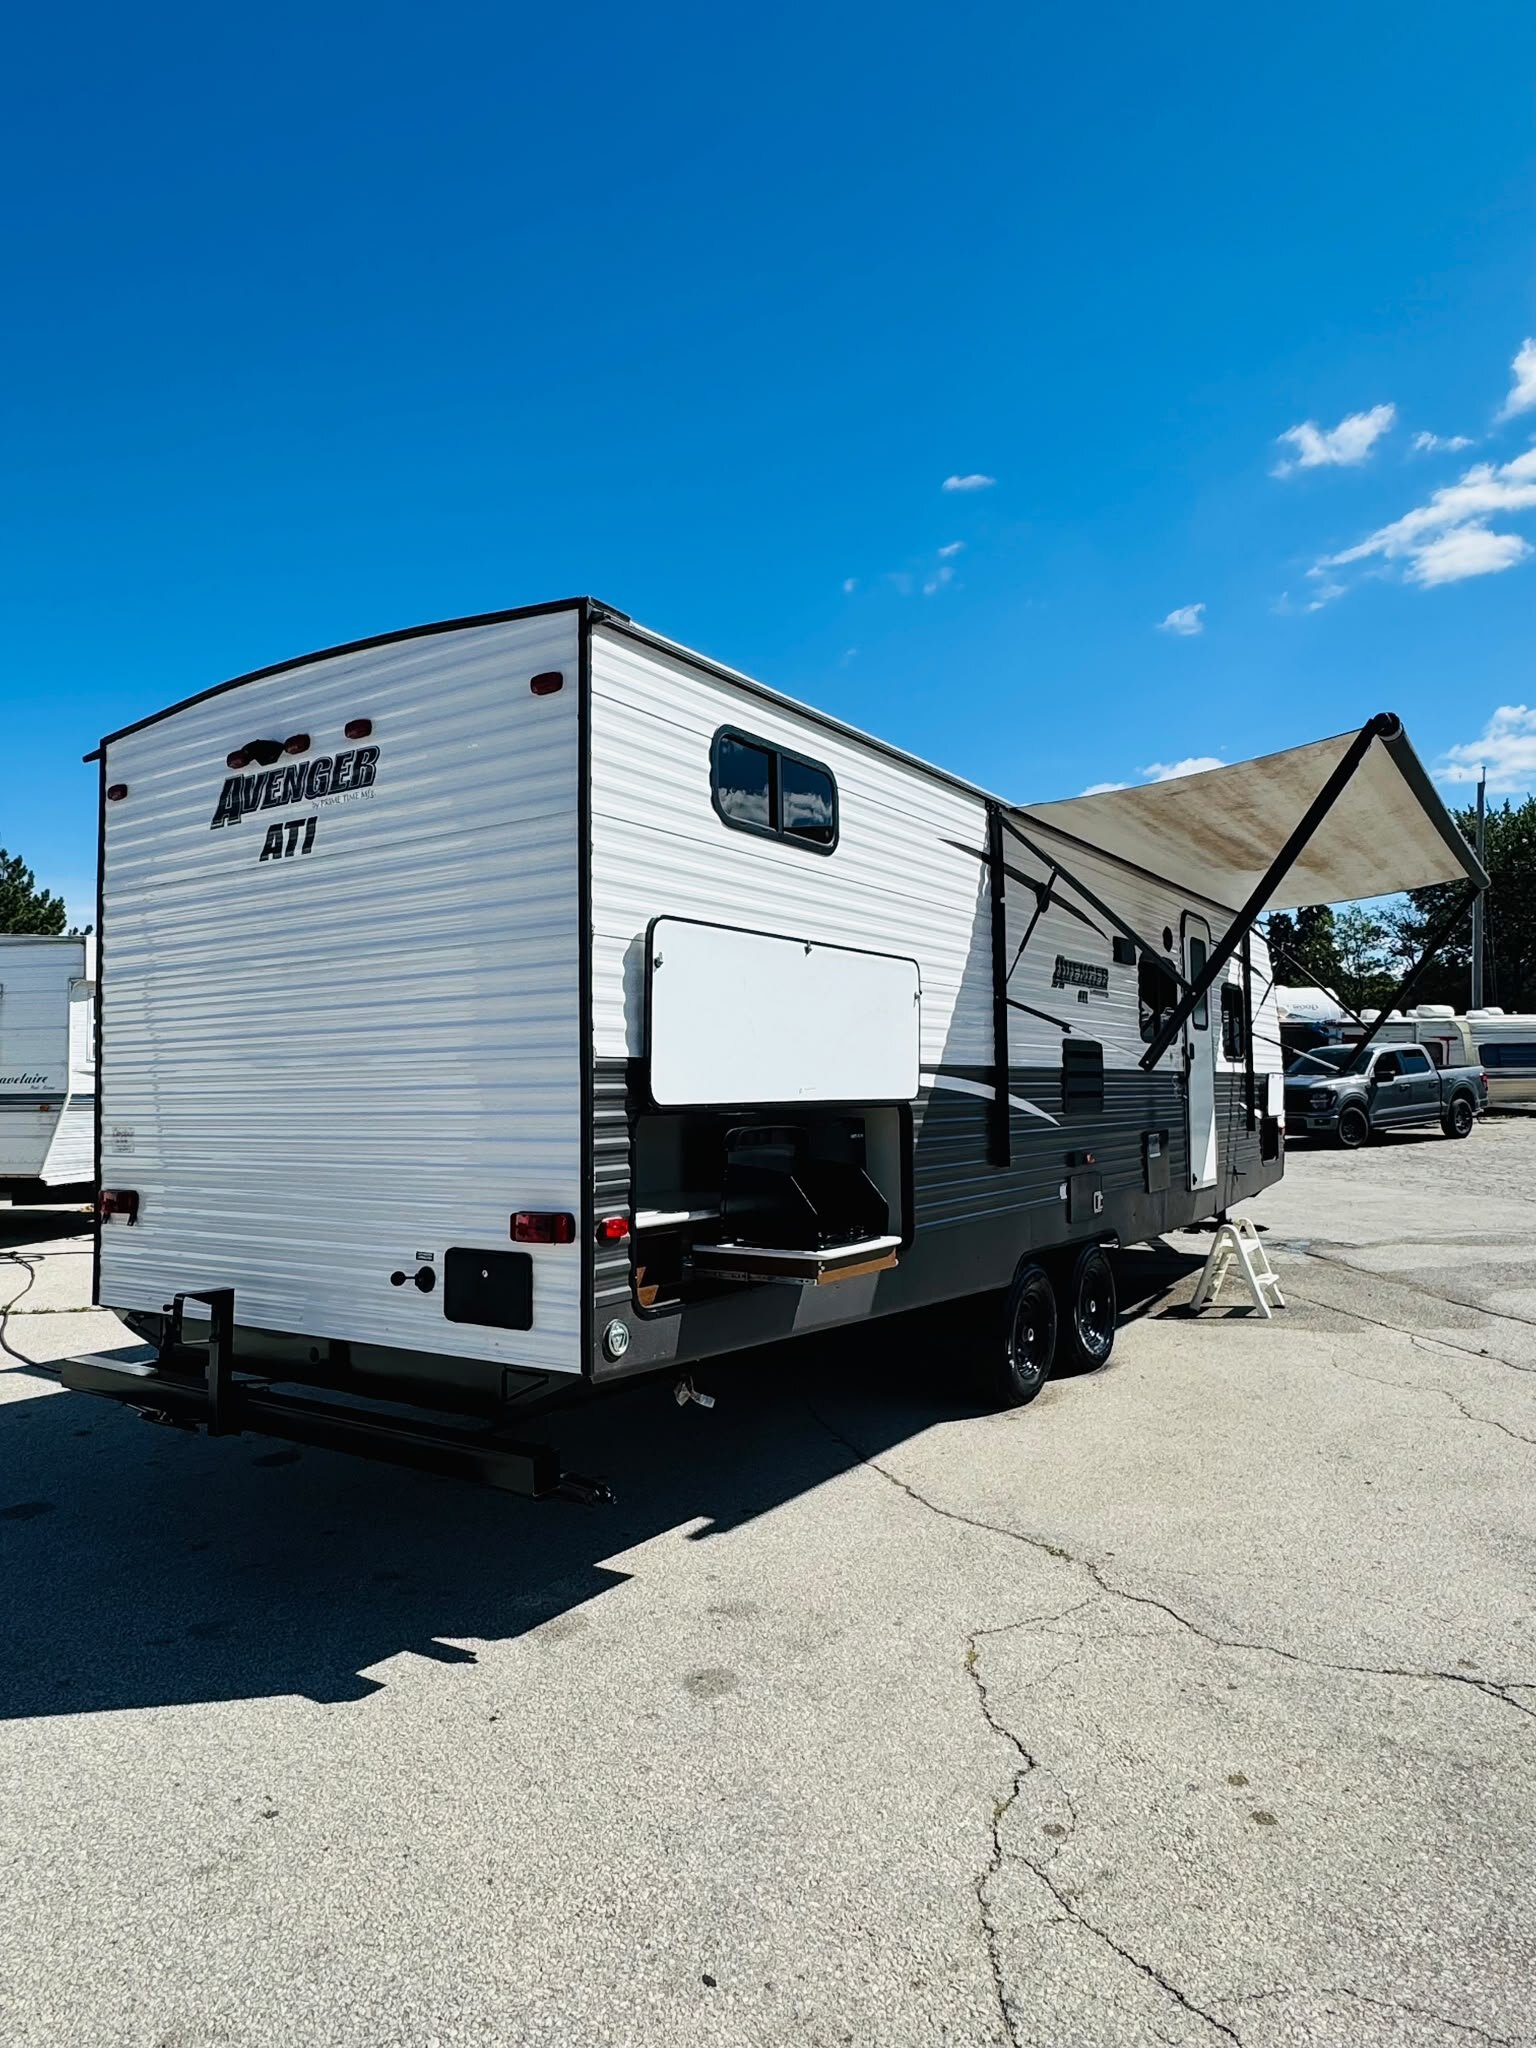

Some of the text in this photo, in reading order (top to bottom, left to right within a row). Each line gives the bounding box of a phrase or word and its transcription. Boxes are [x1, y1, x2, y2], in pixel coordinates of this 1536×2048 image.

[210, 745, 380, 830] AVENGER
[343, 791, 360, 801] TIME
[259, 816, 318, 862] ATI
